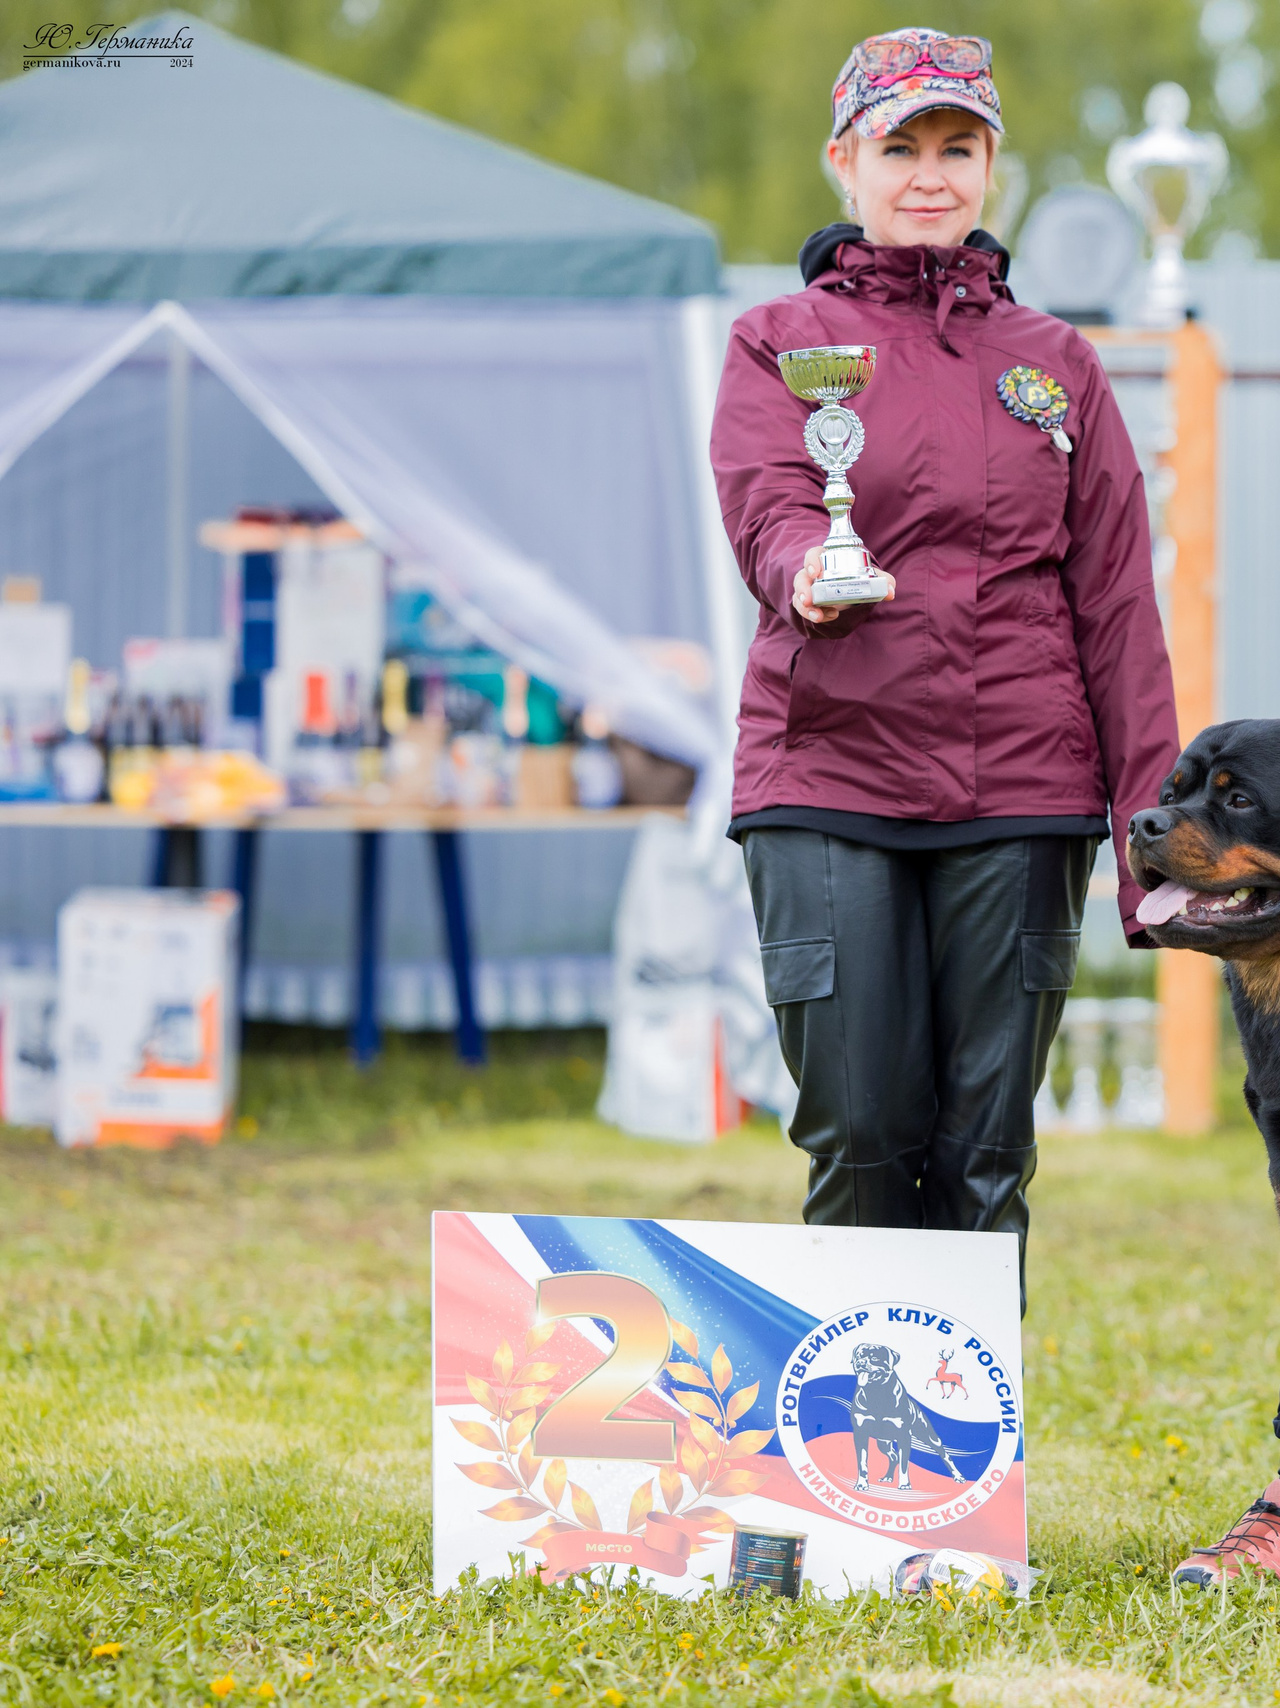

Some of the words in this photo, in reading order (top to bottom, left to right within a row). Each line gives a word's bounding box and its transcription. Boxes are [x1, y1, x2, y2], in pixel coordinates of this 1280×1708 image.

[531, 1271, 677, 1463] 2
[782, 1311, 870, 1426] РОТВЕЙЛЕР
[888, 1307, 955, 1335] КЛУБ
[963, 1337, 1017, 1433] РОССИИ
[798, 1463, 985, 1531] НИЖЕГОРОДСКОЕ
[981, 1468, 1005, 1495] РО
[585, 1543, 633, 1553] место
